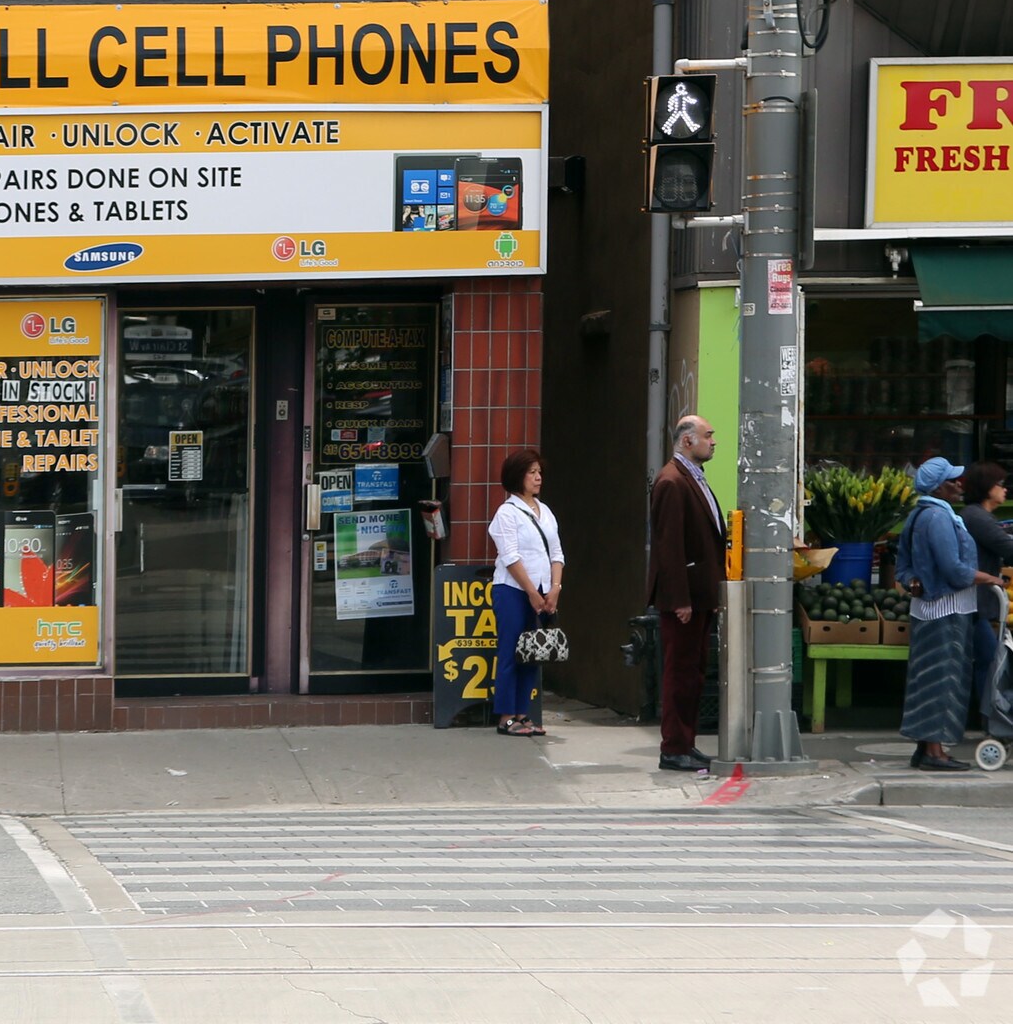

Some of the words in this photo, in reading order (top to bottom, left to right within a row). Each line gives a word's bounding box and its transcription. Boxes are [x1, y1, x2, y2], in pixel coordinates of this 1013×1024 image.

[89, 25, 245, 89] CELL
[267, 21, 520, 86] PHONES
[894, 145, 1010, 172] FRESH
[68, 167, 139, 189] DONE
[148, 166, 188, 188] ON
[197, 166, 242, 188] SITE
[68, 202, 85, 223] &
[93, 199, 188, 221] TABLETS
[74, 251, 136, 263] SAMSUNG
[300, 241, 325, 256] LG
[49, 317, 76, 333] LG
[19, 360, 101, 378] UNLOCK
[3, 381, 19, 400] IN
[16, 430, 31, 448] &
[35, 429, 99, 448] TABLET
[175, 434, 198, 444] OPEN
[22, 454, 99, 472] REPAIRS
[321, 475, 351, 490] OPEN
